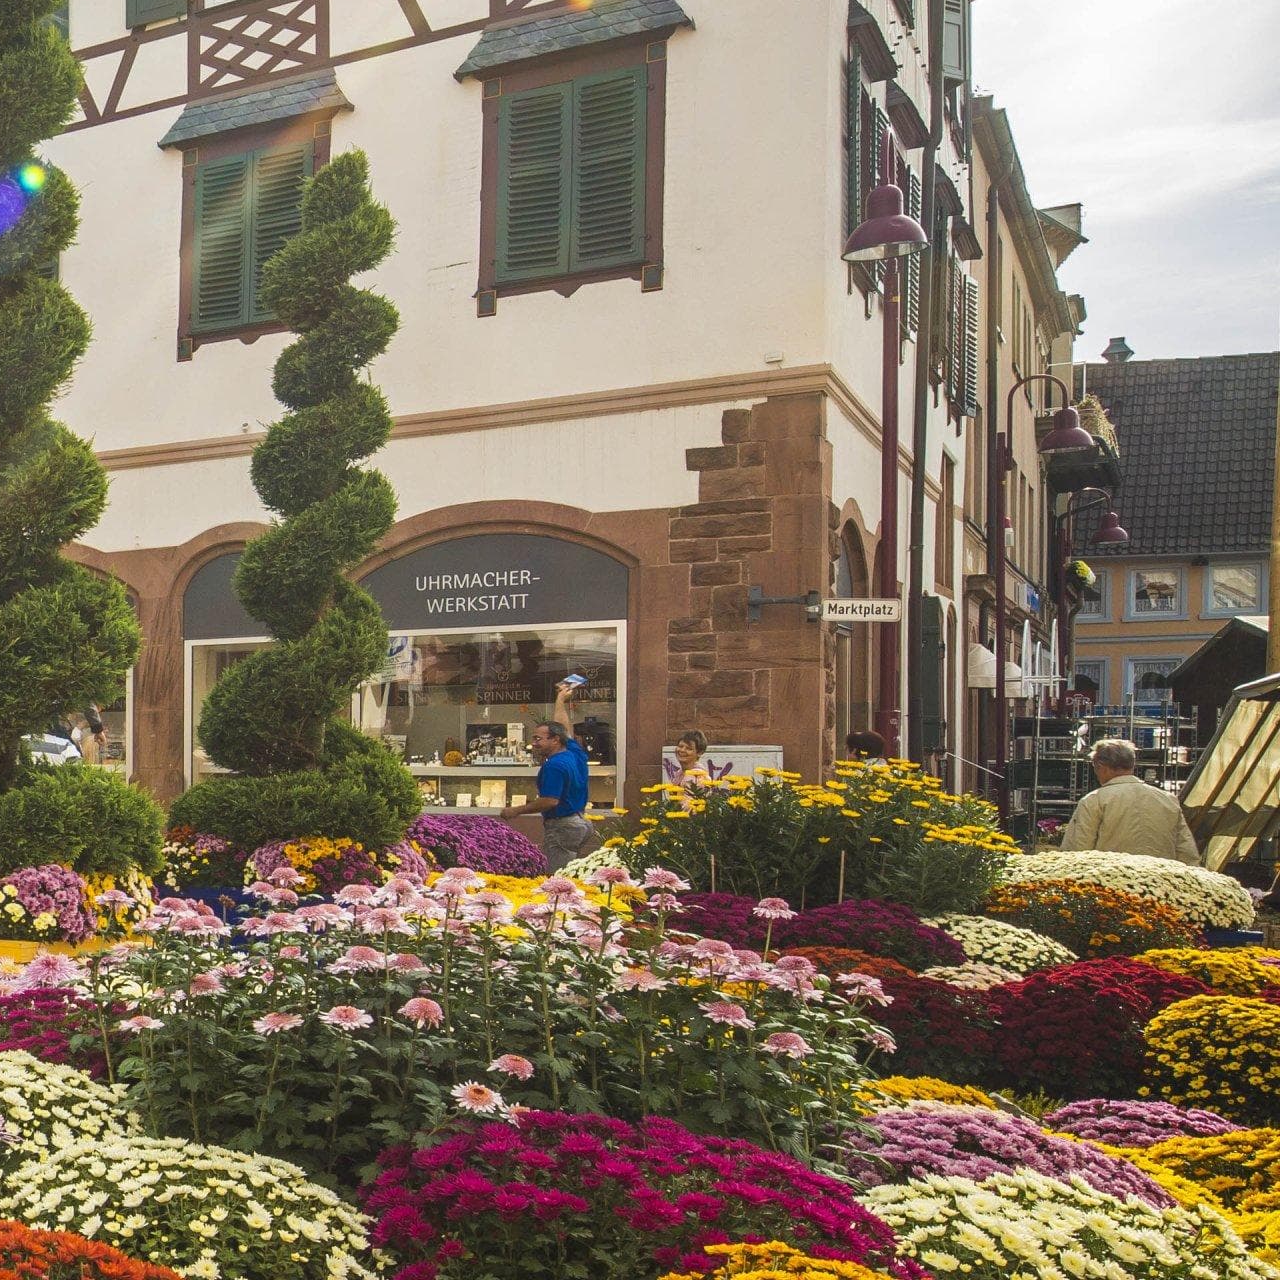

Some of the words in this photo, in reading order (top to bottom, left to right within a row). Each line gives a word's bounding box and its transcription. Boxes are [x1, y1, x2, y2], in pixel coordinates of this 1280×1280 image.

[415, 570, 541, 591] UHRMACHER-
[426, 593, 529, 614] WERKSTATT
[828, 603, 894, 618] Marktplatz
[477, 690, 532, 702] SPINNER
